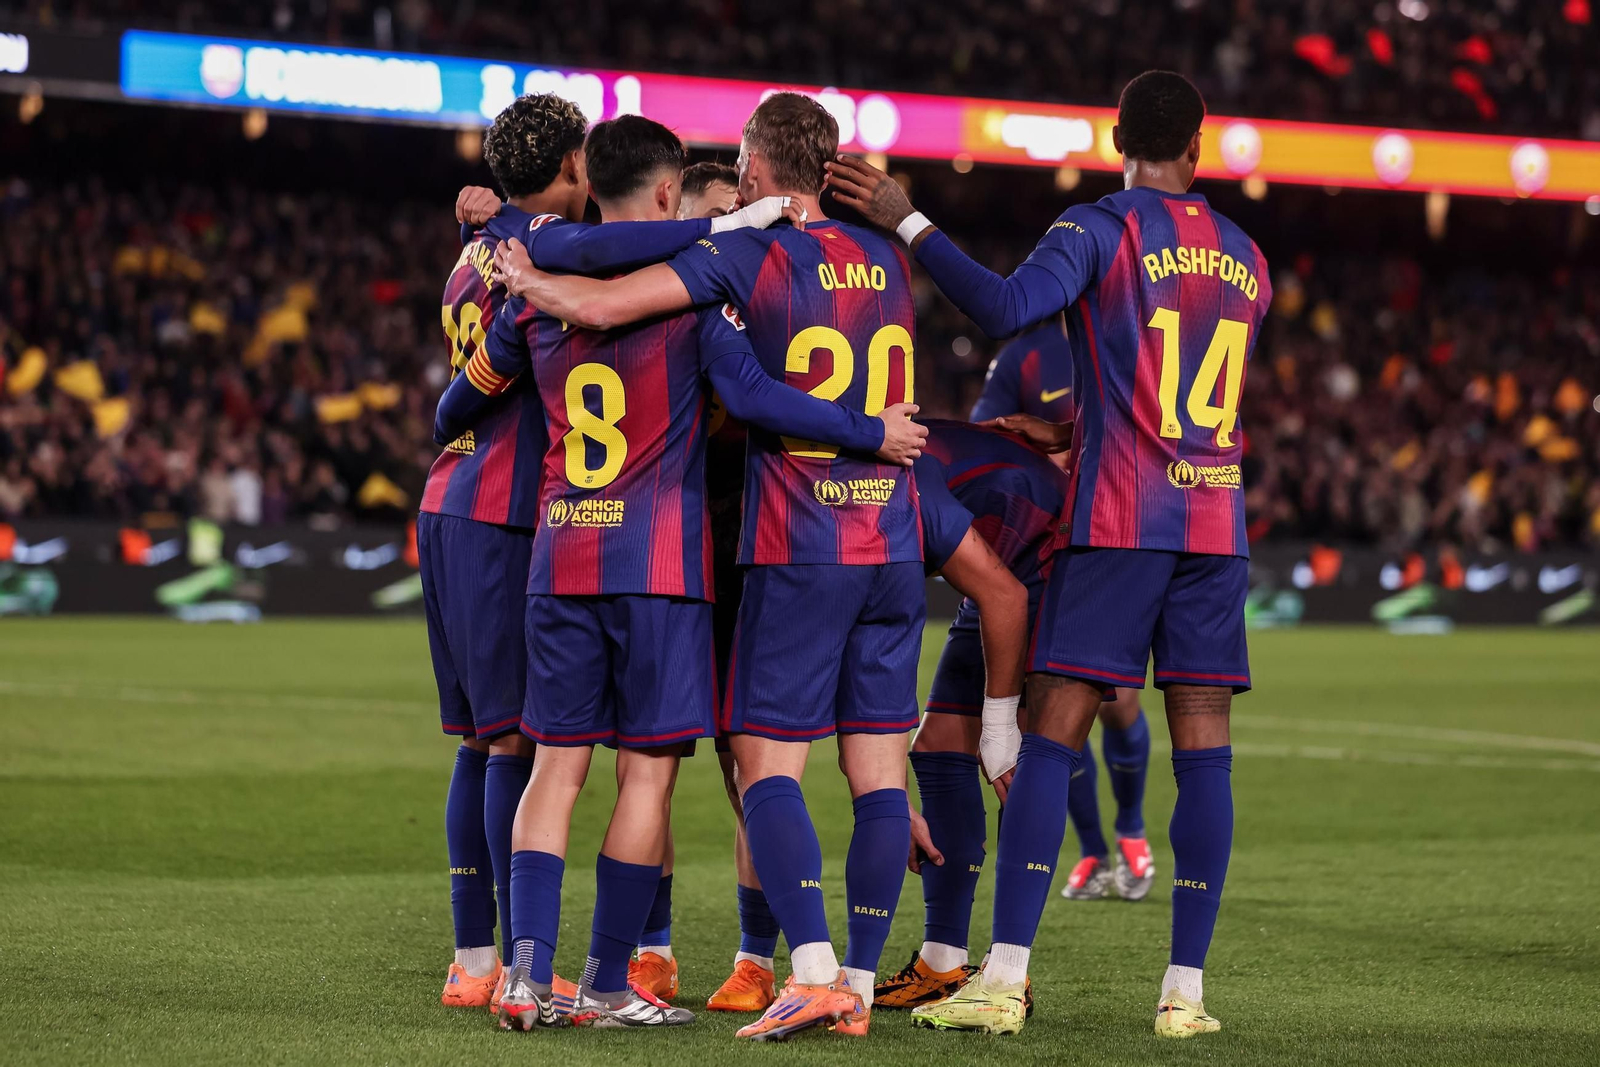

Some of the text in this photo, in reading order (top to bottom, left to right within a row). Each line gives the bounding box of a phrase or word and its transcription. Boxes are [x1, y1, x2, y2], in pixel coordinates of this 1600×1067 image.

[817, 262, 886, 291] OLMO
[1143, 246, 1258, 302] RASHFORD
[1147, 307, 1249, 448] 14
[781, 324, 914, 459] 20
[563, 362, 628, 489] 8
[1197, 464, 1240, 475] UNHCR
[848, 479, 896, 491] UNHCR
[1205, 473, 1241, 485] ACNUR
[575, 499, 625, 512] UNHCR
[571, 510, 624, 523] ACNUR
[854, 905, 889, 917] BARÇA
